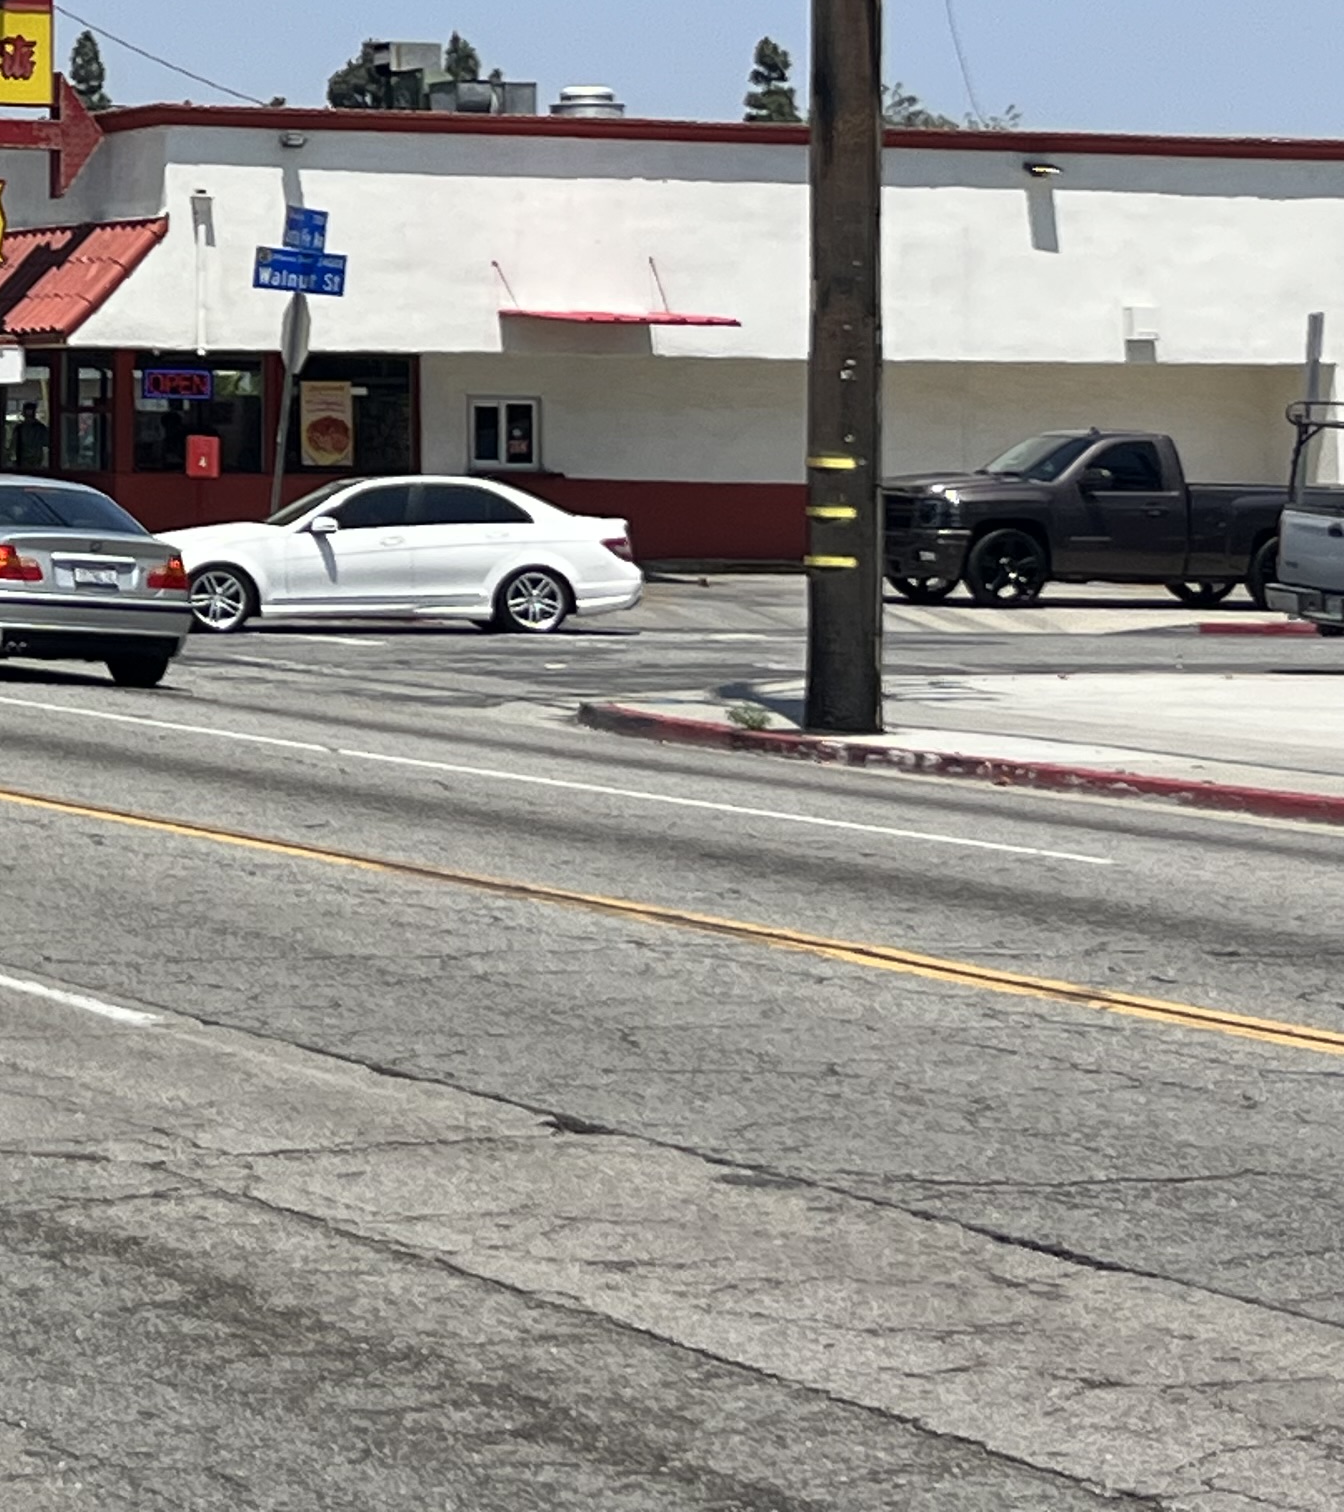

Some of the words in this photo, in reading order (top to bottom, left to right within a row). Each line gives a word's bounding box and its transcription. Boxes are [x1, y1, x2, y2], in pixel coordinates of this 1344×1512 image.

[258, 267, 318, 289] Walnut
[322, 273, 341, 292] St
[150, 374, 208, 395] OPEN
